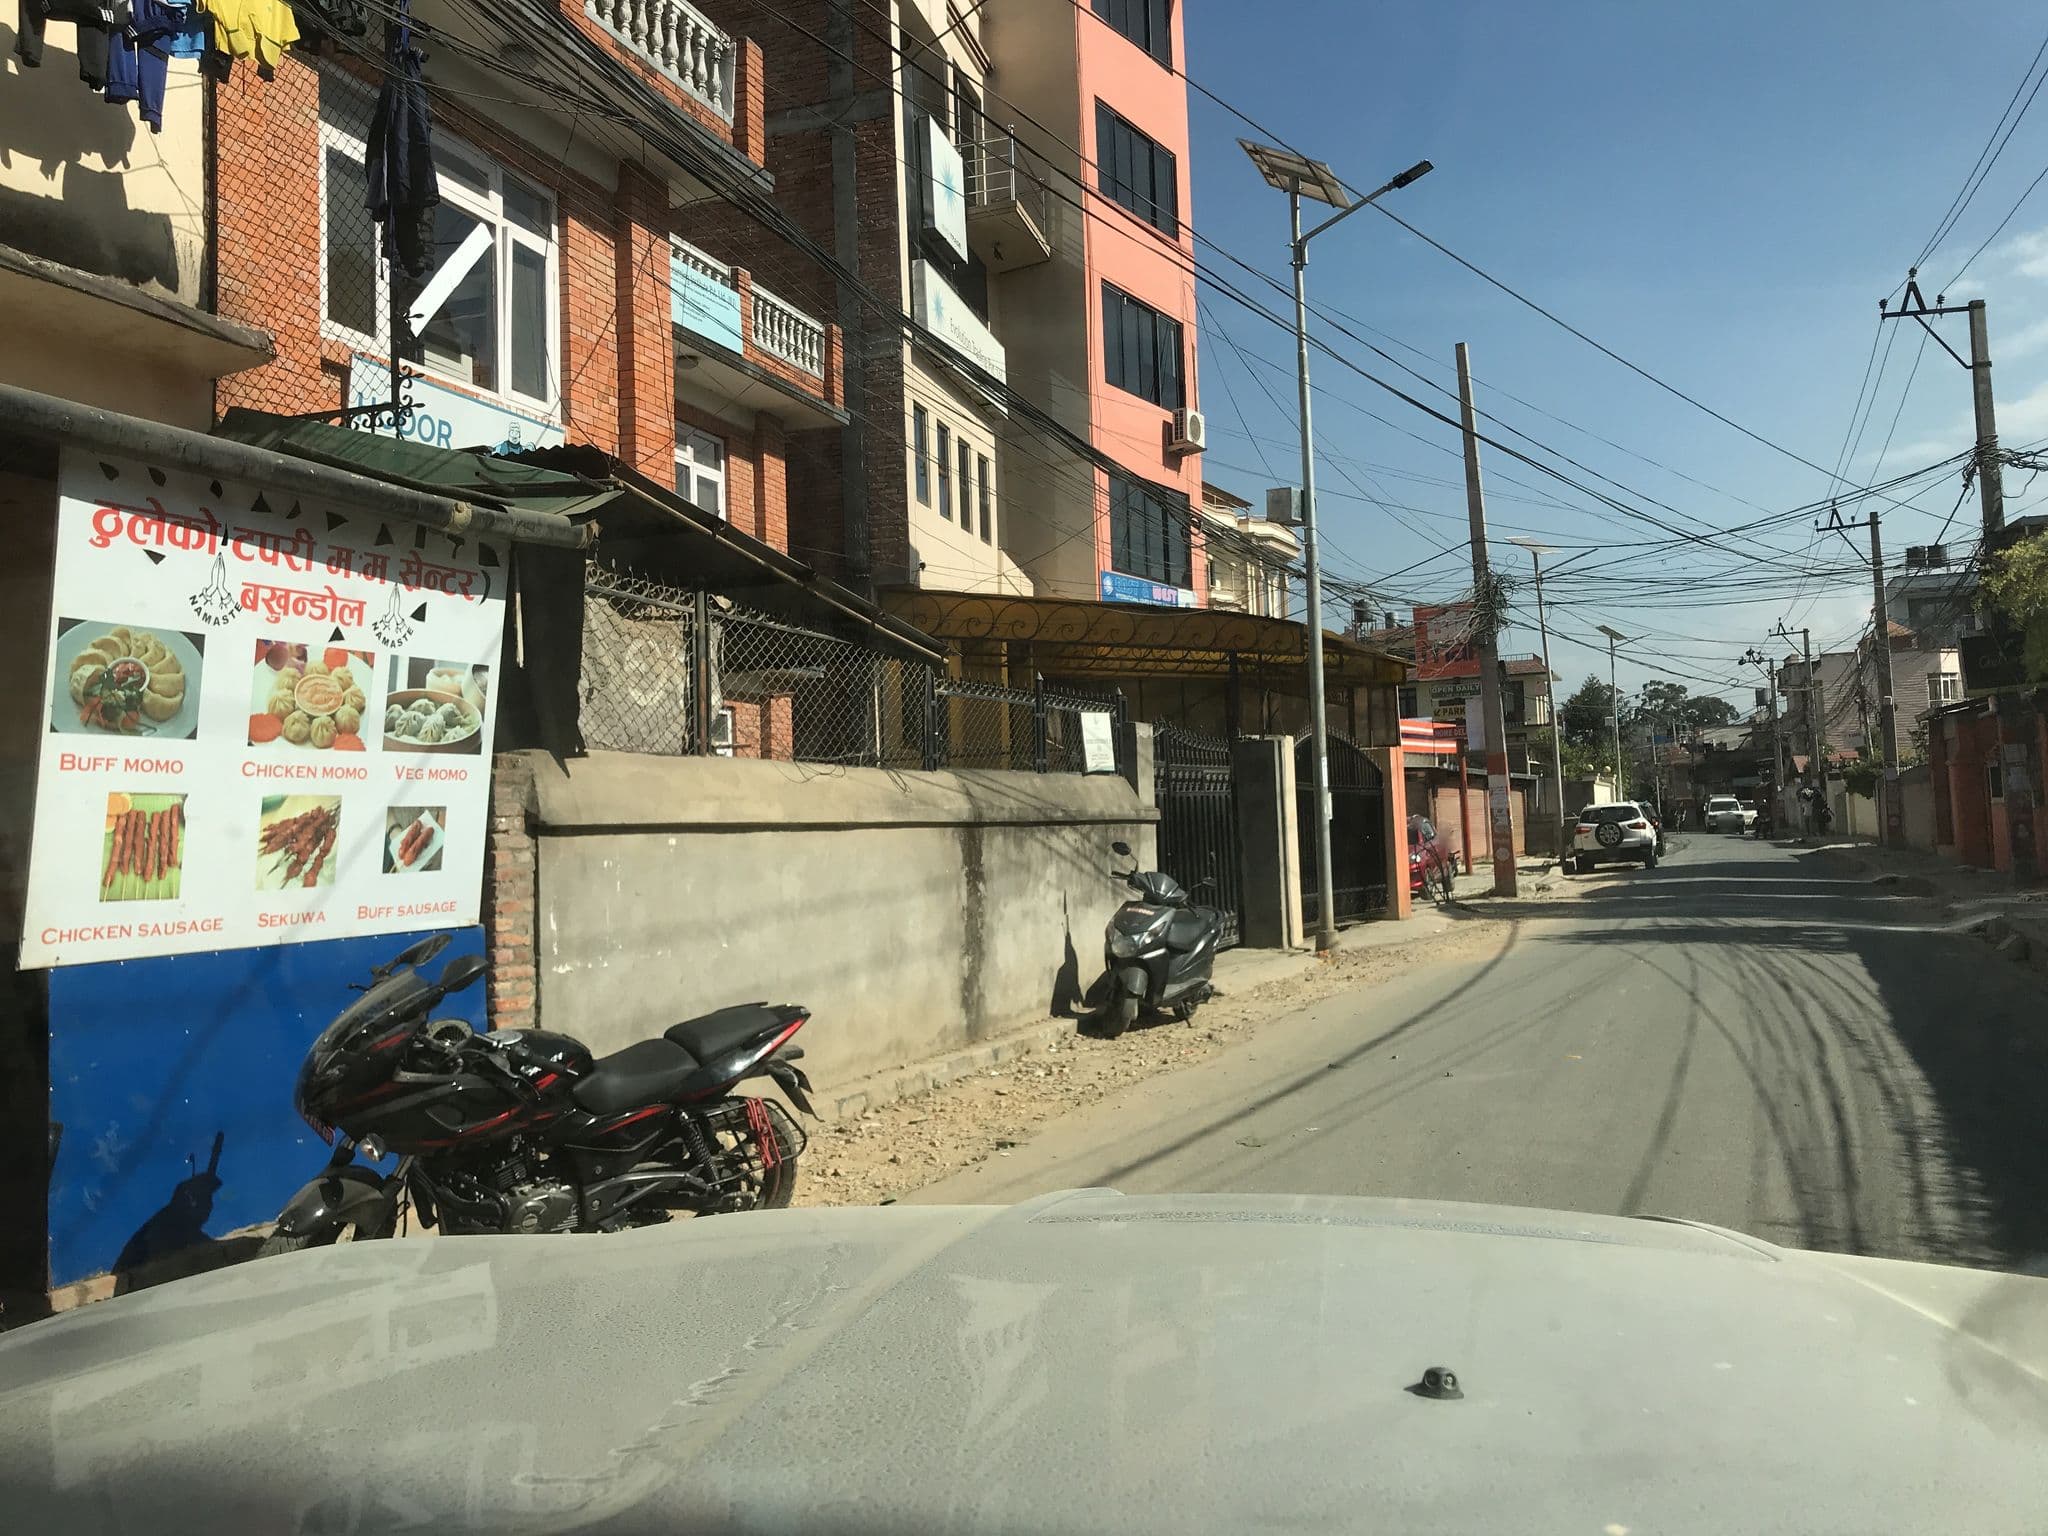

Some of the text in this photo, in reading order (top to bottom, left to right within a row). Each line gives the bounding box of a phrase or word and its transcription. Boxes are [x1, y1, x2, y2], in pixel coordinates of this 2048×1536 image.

[189, 594, 243, 627] NAMASTE
[371, 621, 414, 649] NAMASTE
[59, 753, 184, 775] BUFF MOMO
[241, 761, 368, 780] CHICKEN MOMO
[395, 765, 468, 781] VEG MOMO
[257, 911, 327, 928] SEKUWA
[357, 901, 457, 920] BUFF SAUSAGE
[40, 918, 224, 945] CHICKEN SAUSAGE
